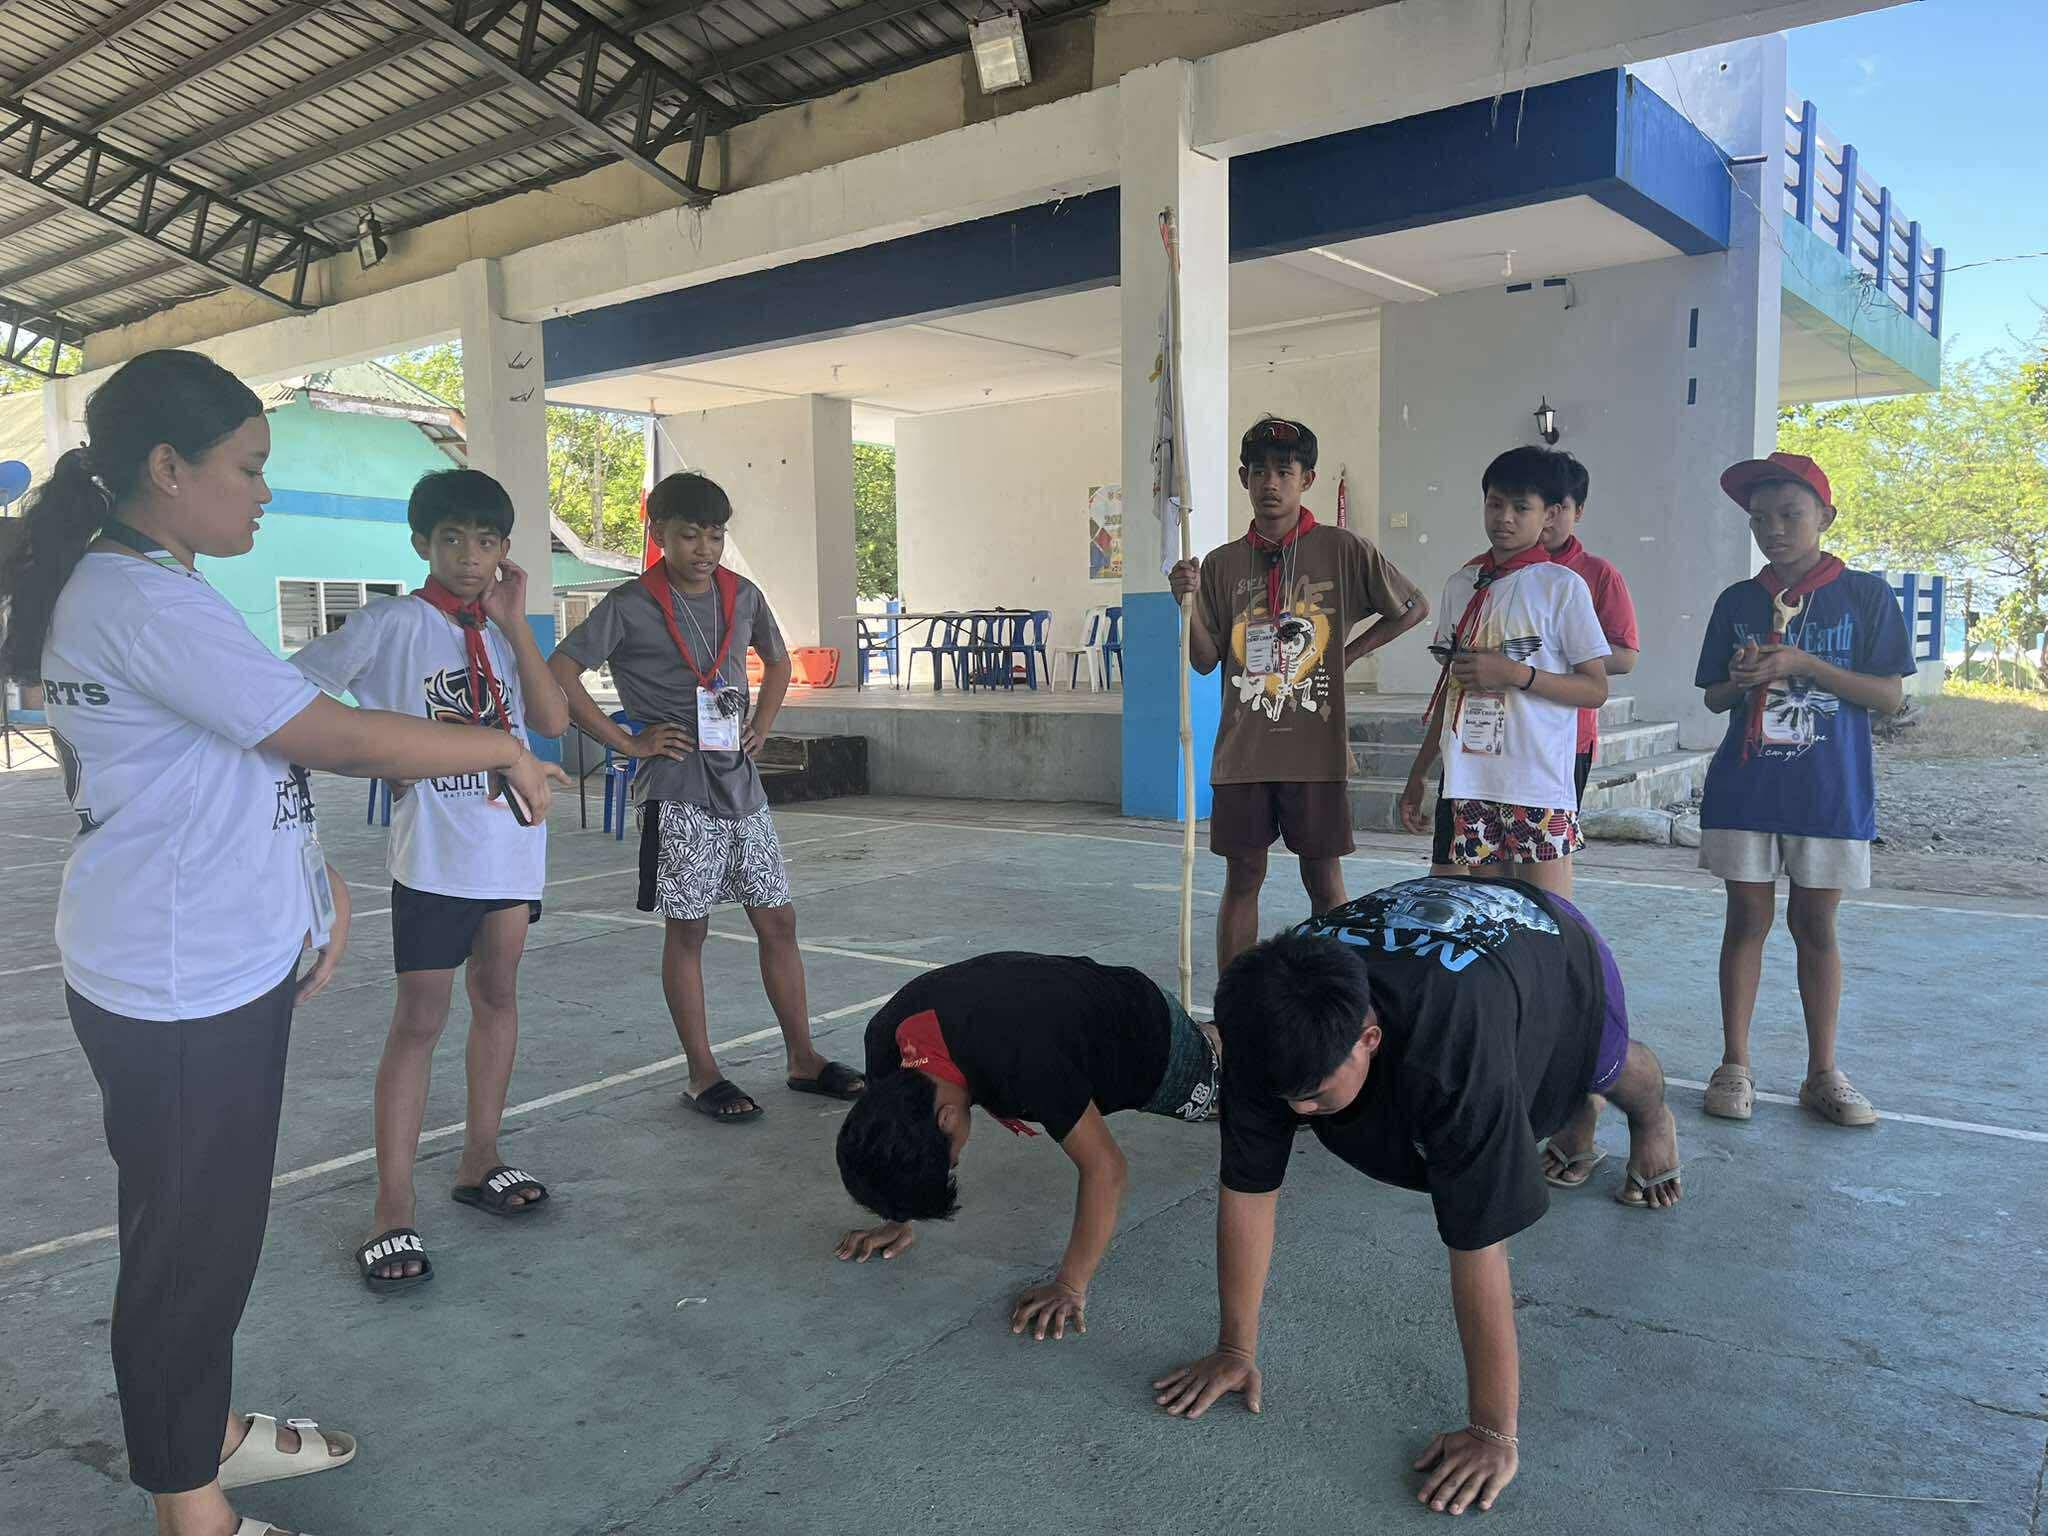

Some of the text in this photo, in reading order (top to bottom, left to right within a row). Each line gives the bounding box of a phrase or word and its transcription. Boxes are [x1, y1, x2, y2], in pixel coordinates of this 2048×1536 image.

[1805, 612, 1853, 652] Earth
[42, 680, 110, 706] RTS
[364, 1234, 424, 1266] NIKE
